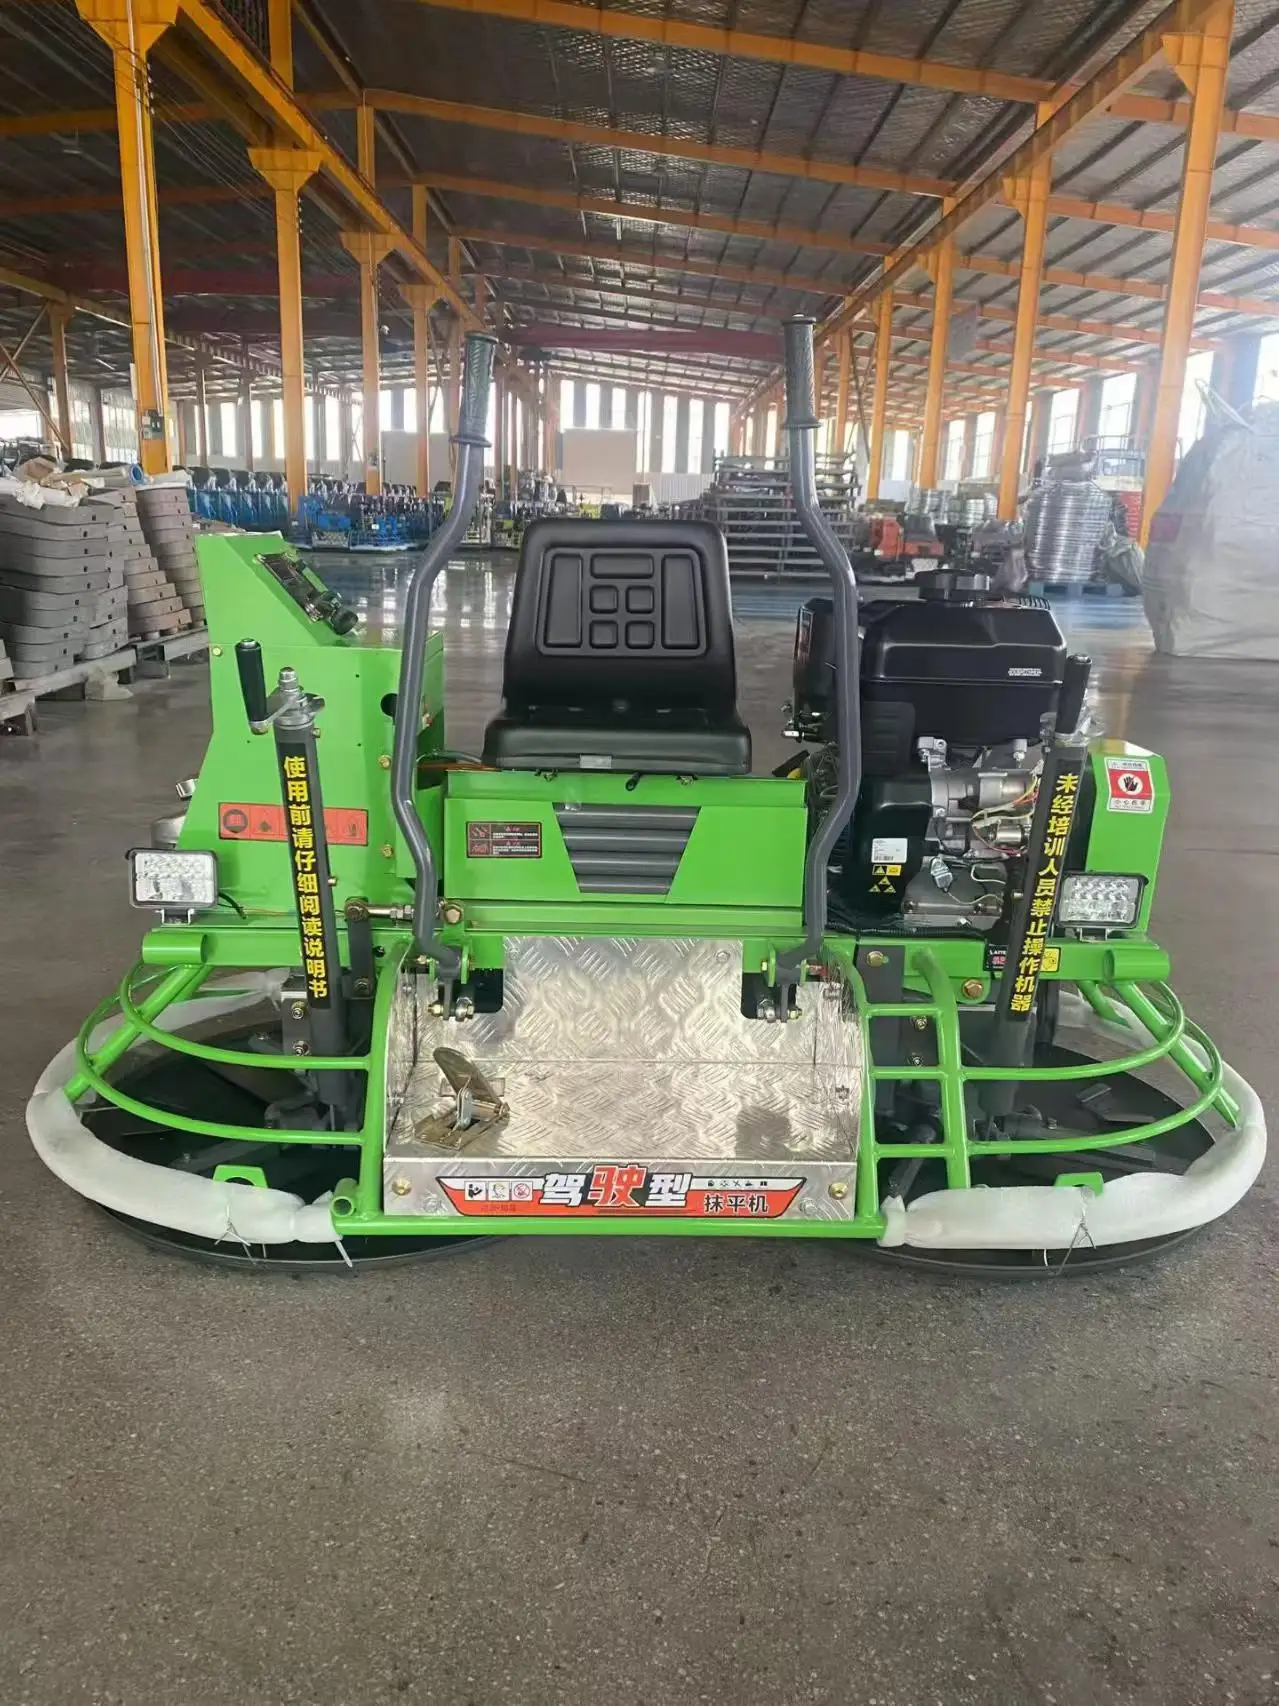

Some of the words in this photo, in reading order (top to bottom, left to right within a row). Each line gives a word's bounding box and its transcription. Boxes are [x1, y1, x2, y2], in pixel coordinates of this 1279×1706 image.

[284, 756, 328, 998] 使用前请仔细阅读说明书
[1010, 773, 1079, 1012] 未经培训人员禁止操作机器
[541, 1165, 692, 1207] 驾驶型
[703, 1194, 768, 1213] 抹平机
